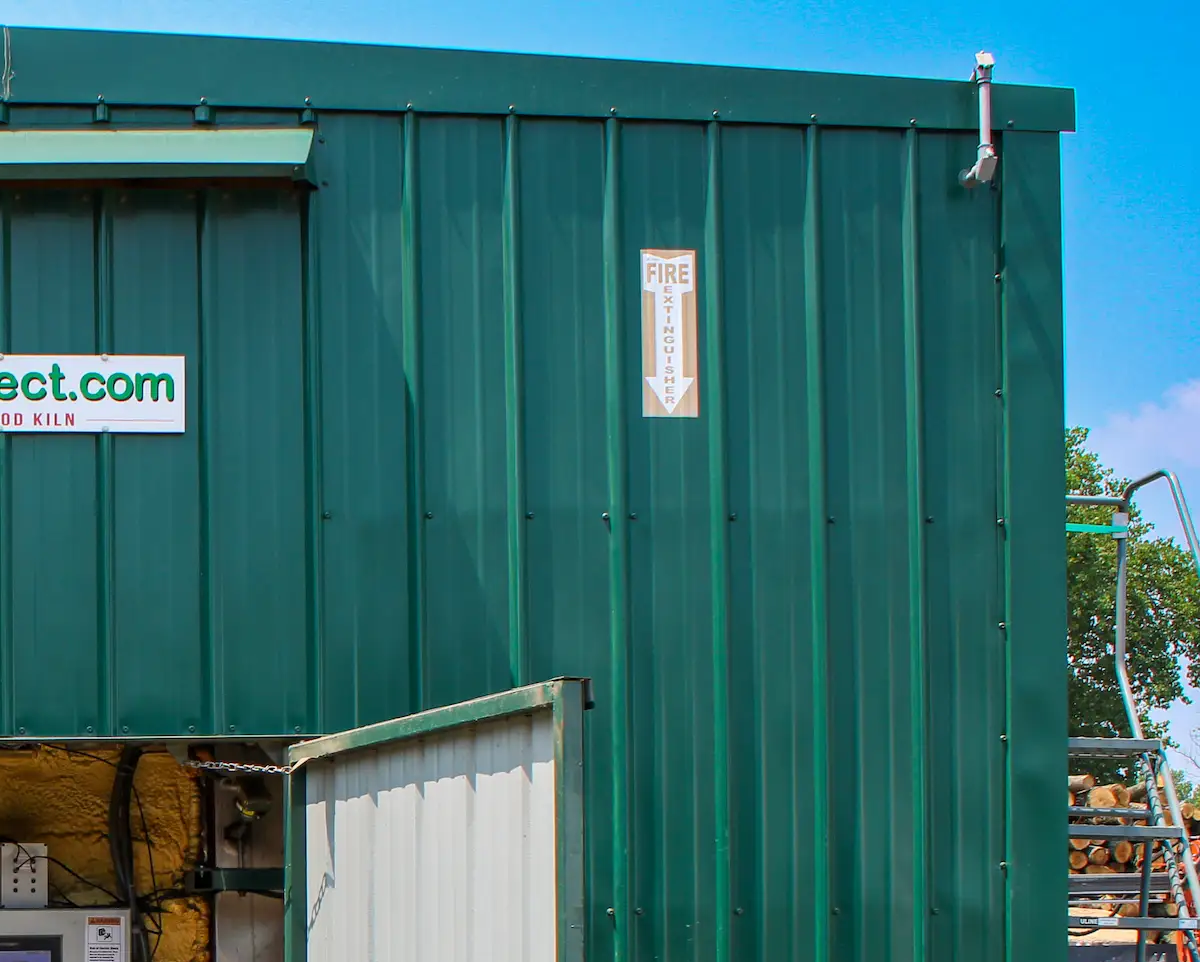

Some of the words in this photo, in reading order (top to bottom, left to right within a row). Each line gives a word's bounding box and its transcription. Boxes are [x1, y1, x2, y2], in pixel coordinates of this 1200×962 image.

[646, 262, 689, 284] FIRE
[663, 285, 676, 404] EXTINGUISHER
[33, 412, 76, 427] KILN
